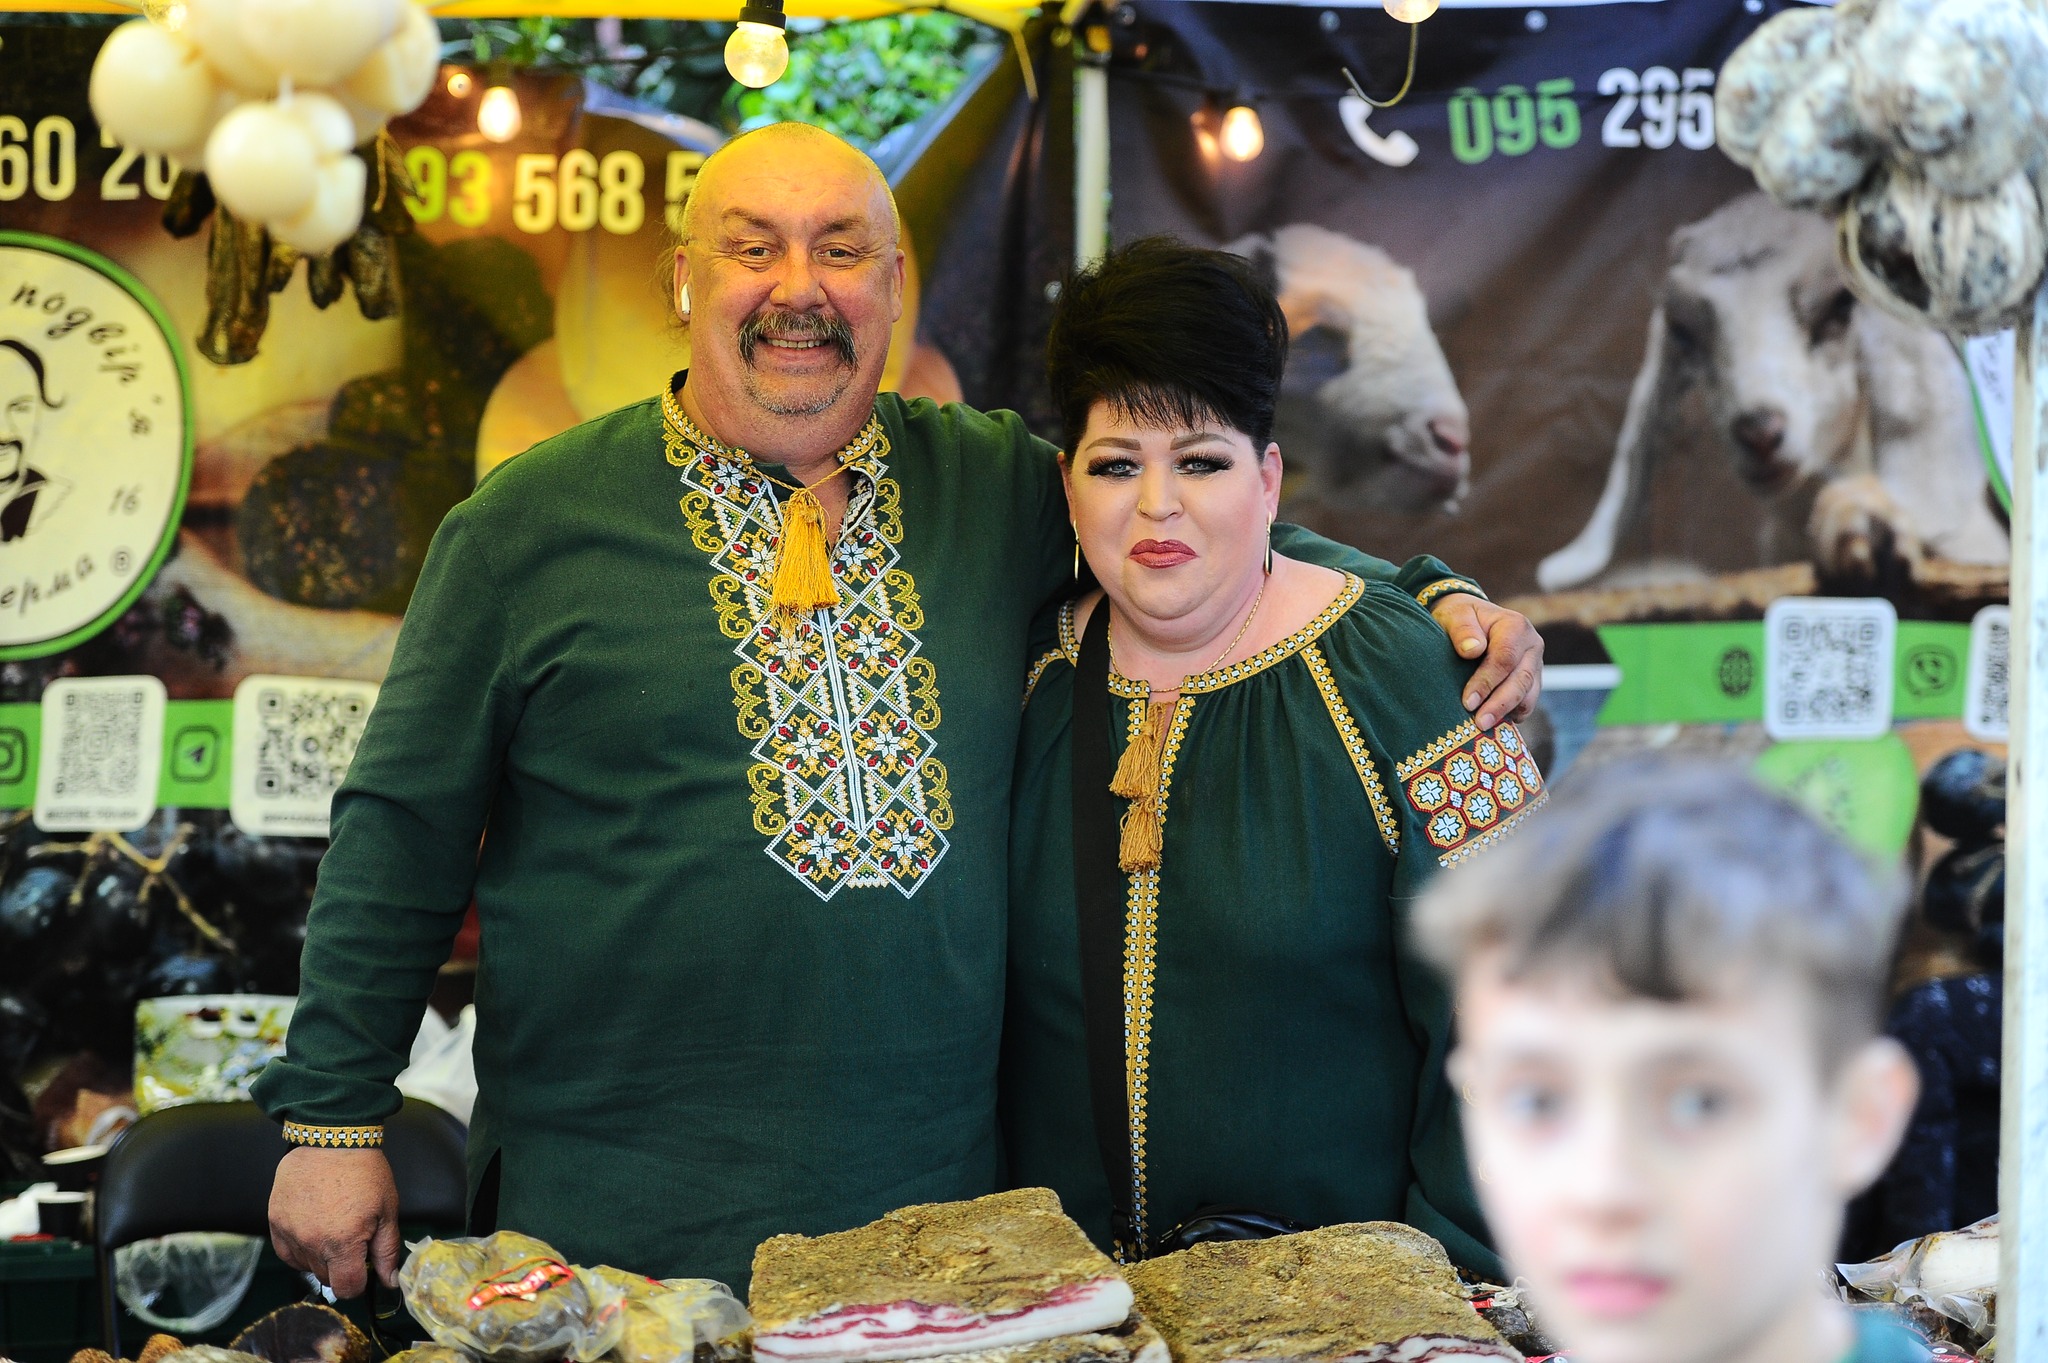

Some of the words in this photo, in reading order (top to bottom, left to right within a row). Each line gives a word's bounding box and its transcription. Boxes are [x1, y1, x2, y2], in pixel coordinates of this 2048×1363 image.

[1448, 77, 1582, 164] 095
[1597, 66, 1716, 150] 295
[512, 149, 645, 235] 568
